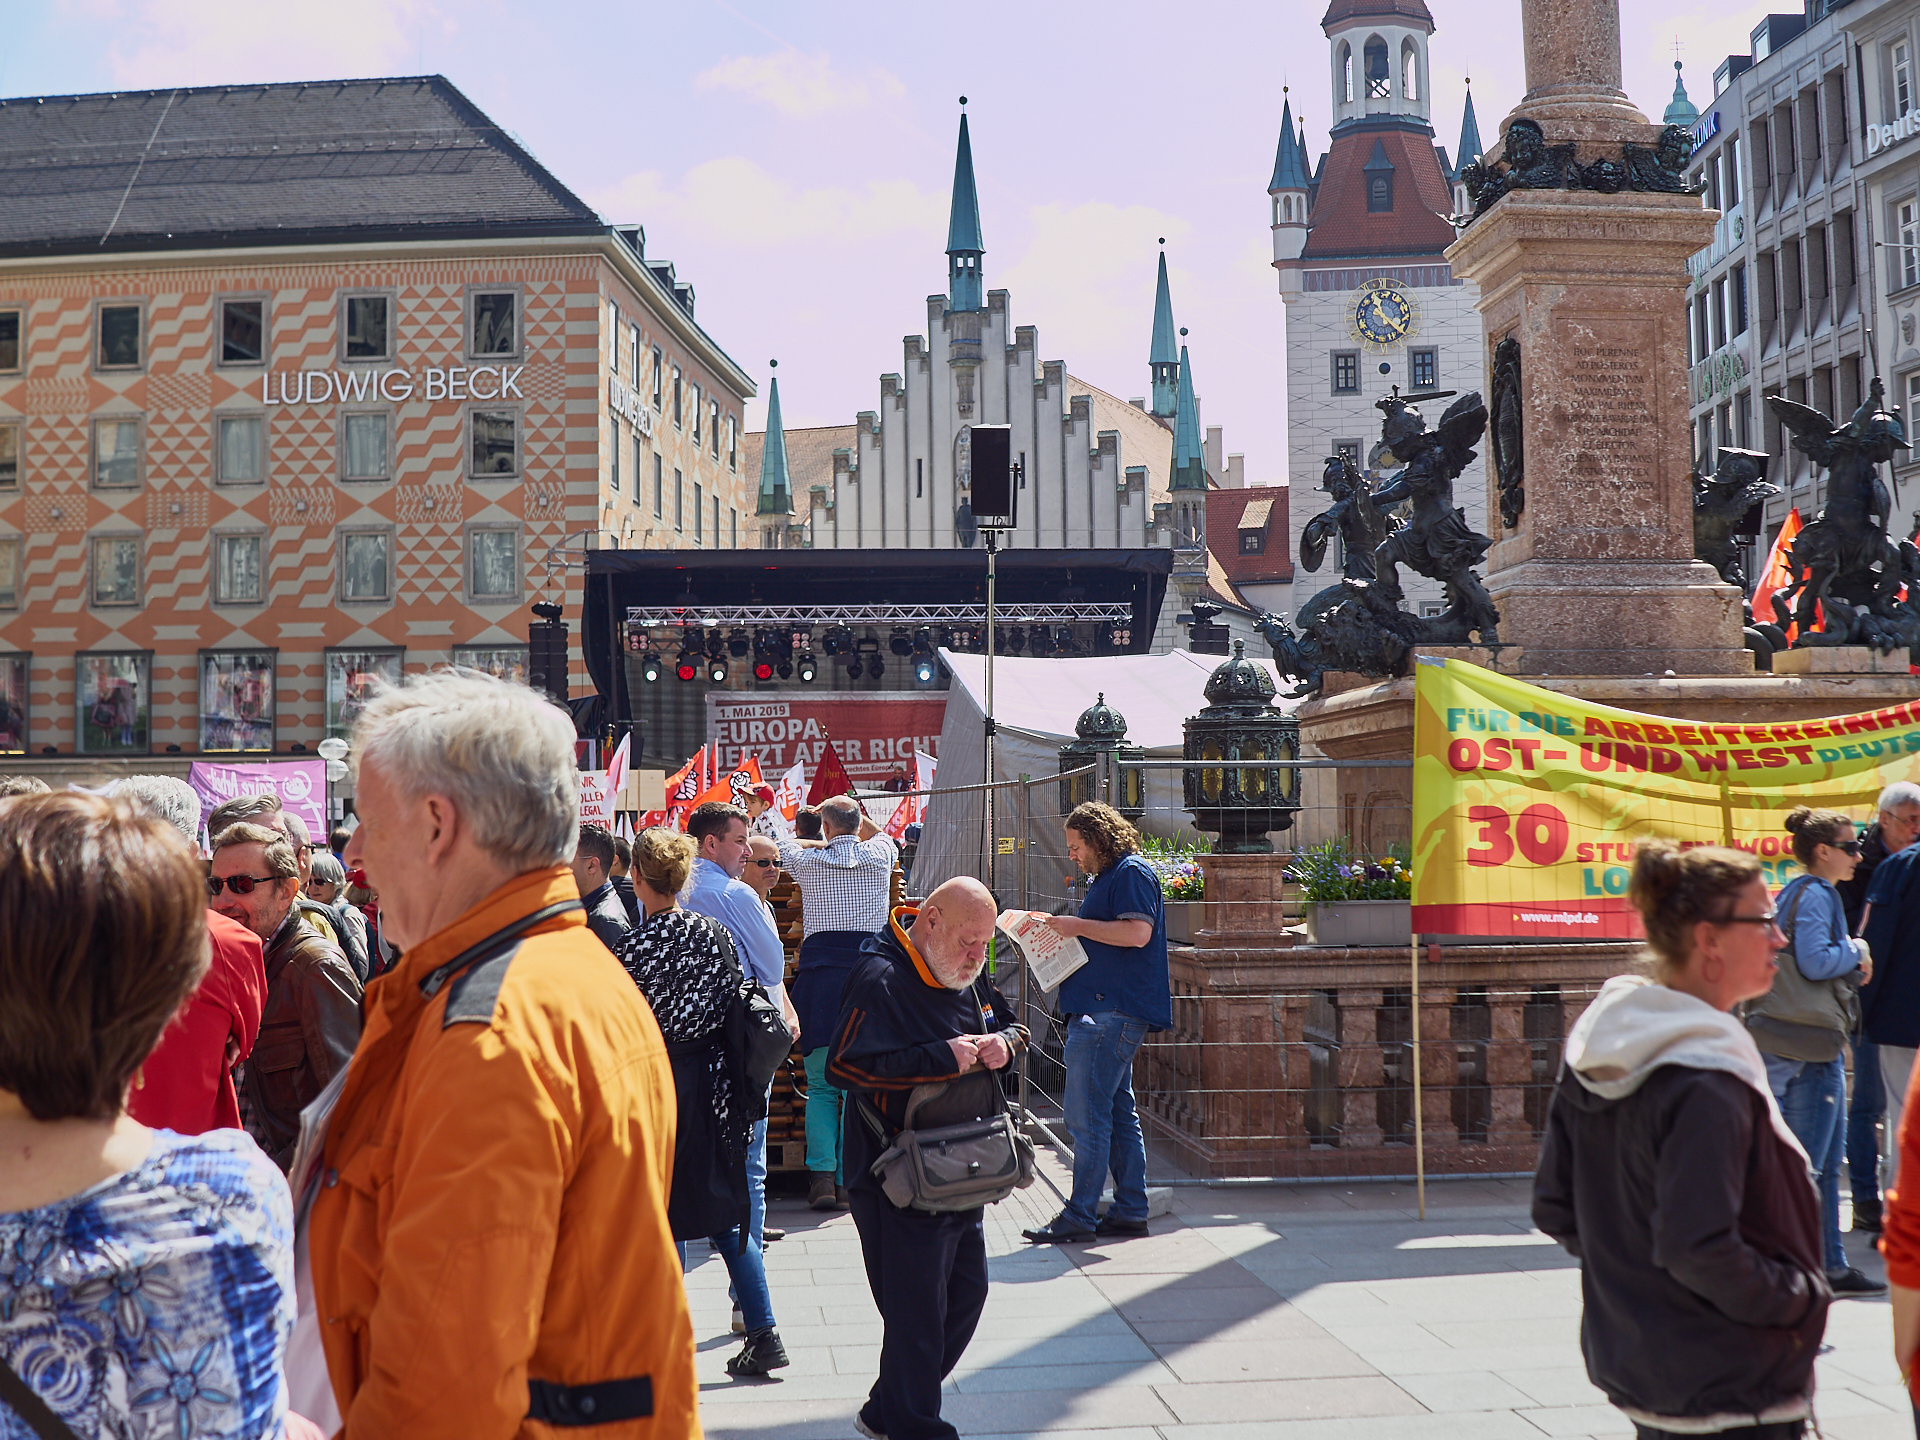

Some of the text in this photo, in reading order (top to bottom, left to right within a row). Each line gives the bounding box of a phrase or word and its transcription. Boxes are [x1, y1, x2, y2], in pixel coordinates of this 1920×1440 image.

[1690, 111, 1719, 157] KLINIK
[262, 365, 525, 405] LUDWIG BECK
[732, 706, 756, 718] MAI
[759, 705, 786, 717] 2019
[1447, 708, 1510, 732] FÜR
[1518, 711, 1576, 736] DIE
[845, 765, 870, 773] rechtes
[1447, 737, 1568, 772] OST-
[1579, 742, 1683, 774] UND
[1467, 802, 1570, 868] 30
[1520, 912, 1600, 925] www.mlpd.de
